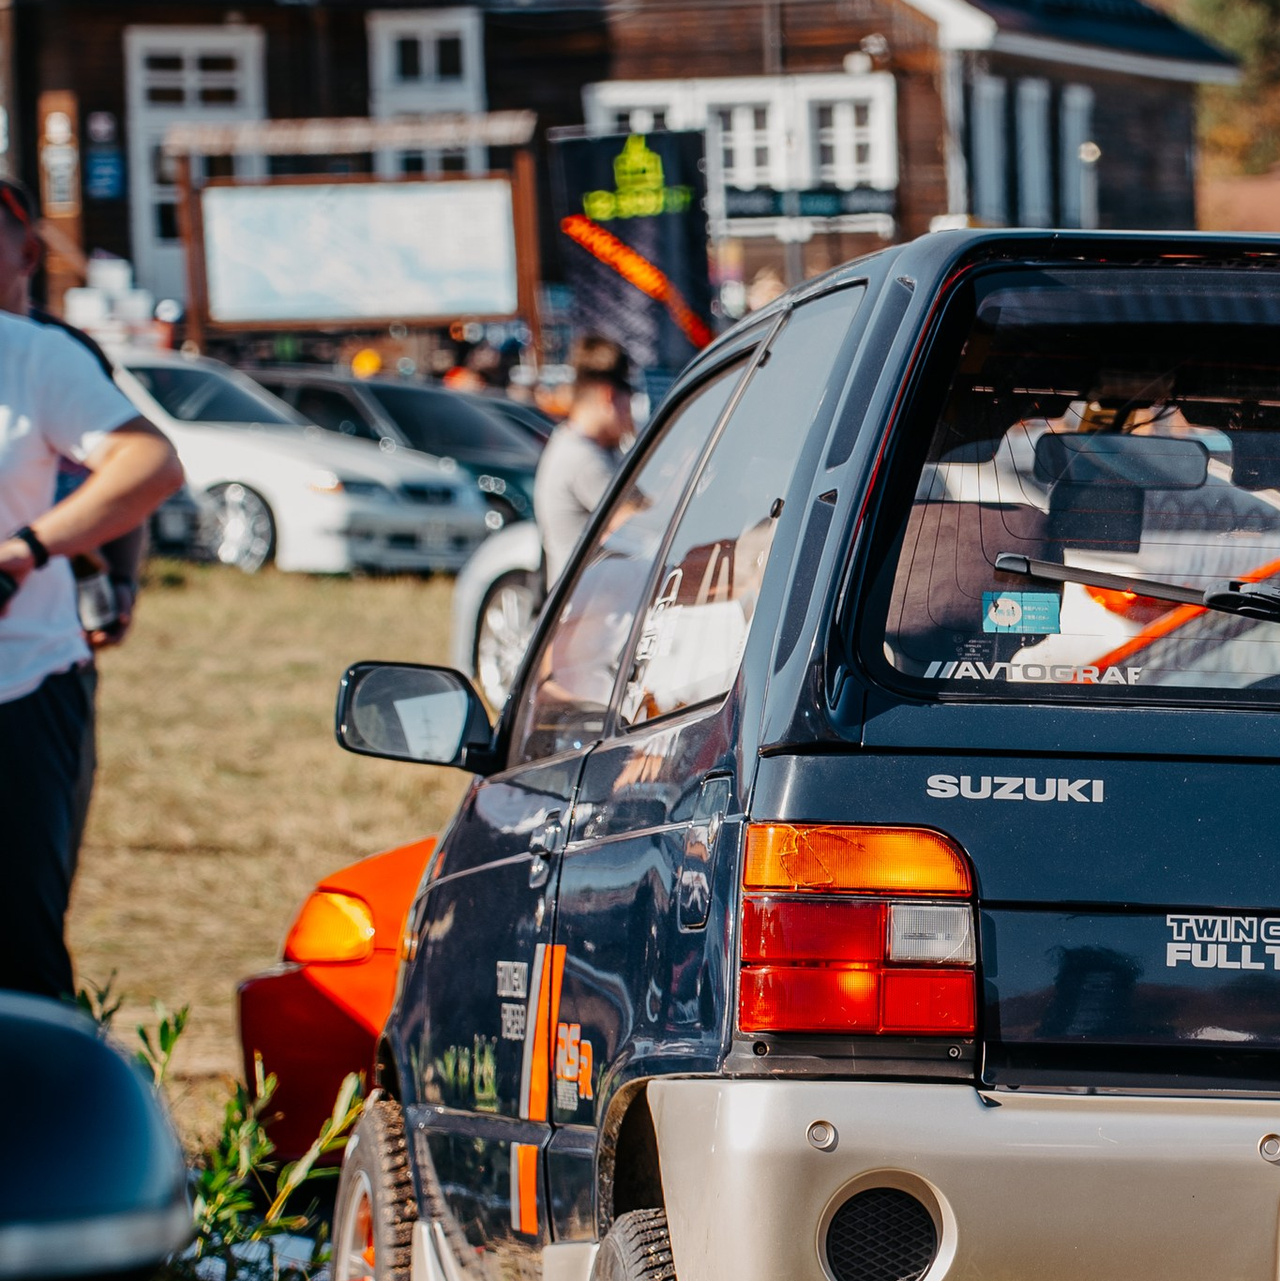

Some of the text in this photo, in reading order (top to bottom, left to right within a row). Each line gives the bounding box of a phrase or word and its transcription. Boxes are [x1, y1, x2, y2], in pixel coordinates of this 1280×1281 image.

[926, 774, 1104, 803] SUZUKI
[1166, 914, 1257, 943] TWIN
[1166, 942, 1265, 970] FULL
